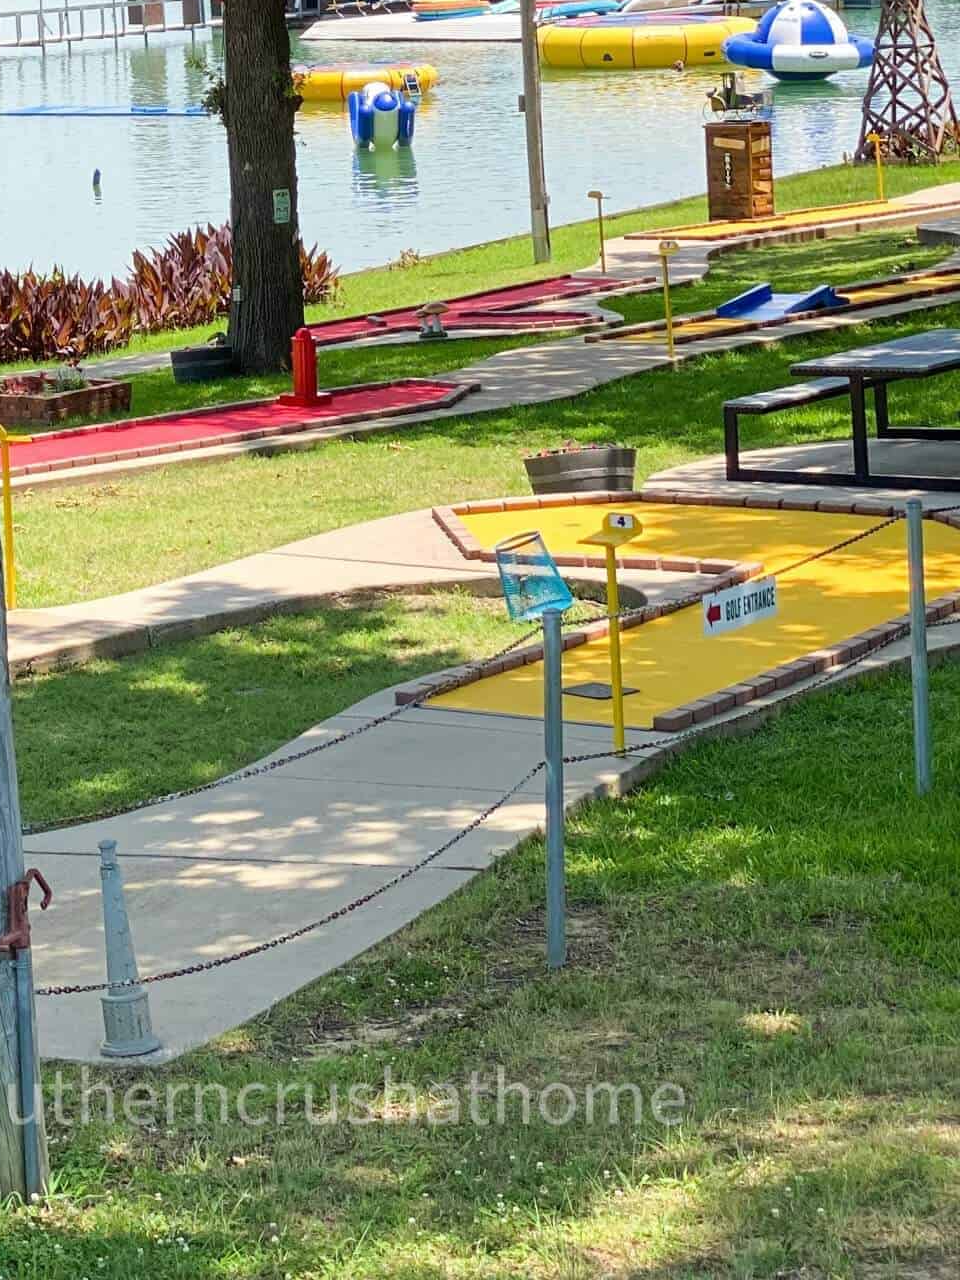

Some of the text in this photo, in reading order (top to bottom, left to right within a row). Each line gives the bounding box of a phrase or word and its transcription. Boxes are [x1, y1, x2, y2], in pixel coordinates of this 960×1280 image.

[617, 516, 625, 527] 4
[726, 586, 775, 621] GOLF ENTRANCE
